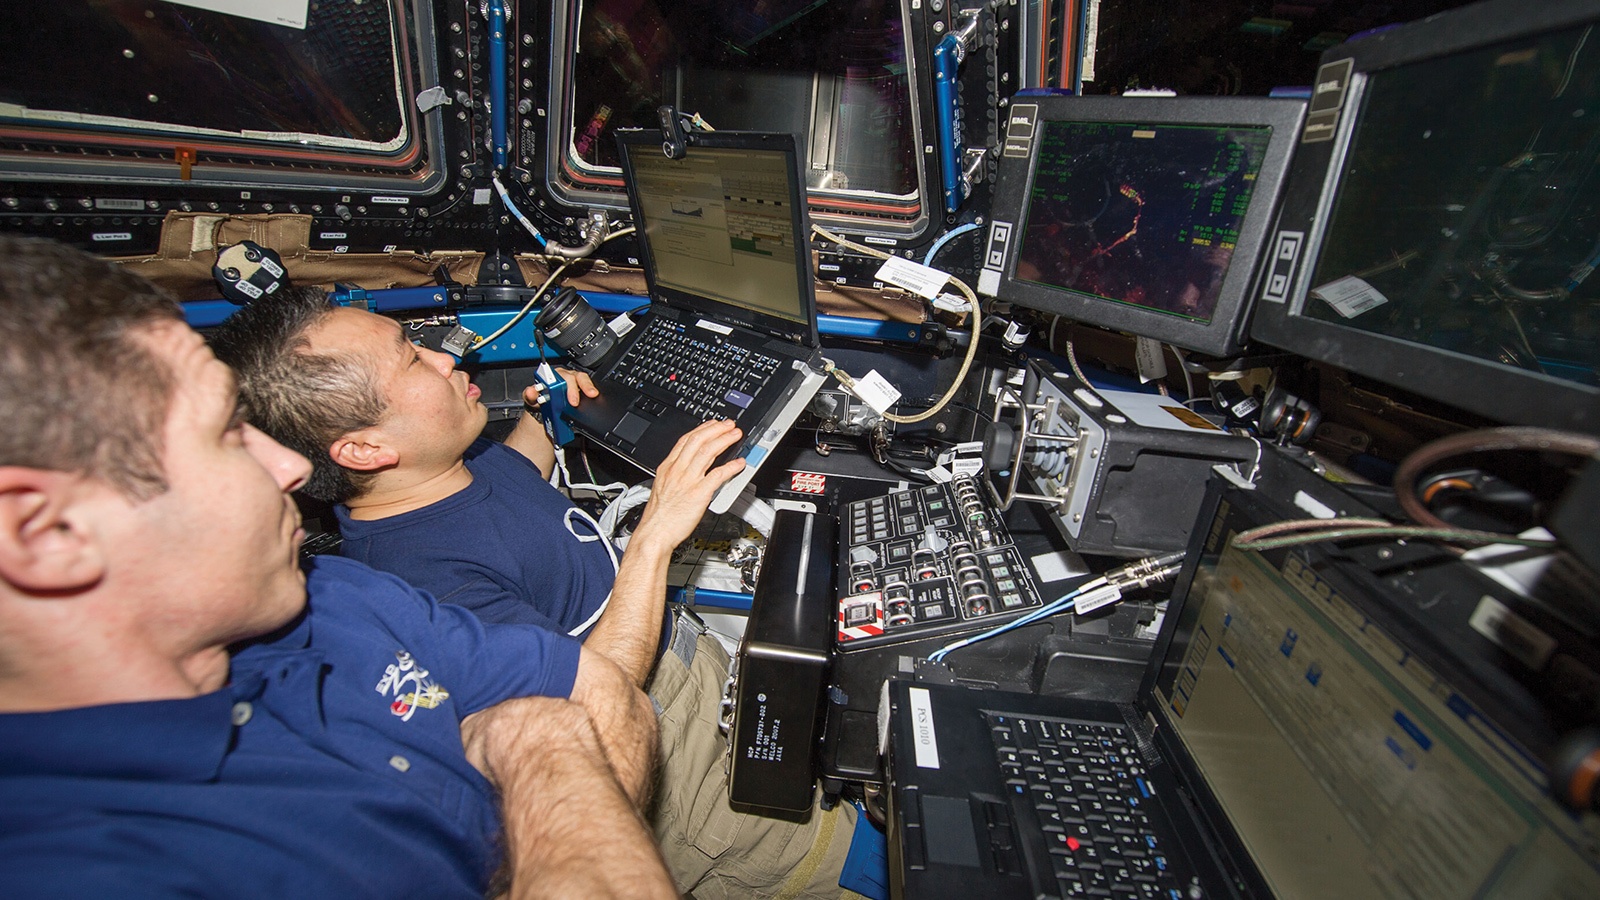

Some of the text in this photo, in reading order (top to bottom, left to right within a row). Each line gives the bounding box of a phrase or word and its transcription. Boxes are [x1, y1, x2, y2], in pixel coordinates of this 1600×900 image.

[771, 719, 780, 740] 2007.2
[916, 707, 930, 745] PCS 1010
[775, 746, 783, 762] JAXA
[1078, 765, 1088, 773] W
[1071, 804, 1080, 812] F
[1092, 802, 1102, 810] R
[1051, 812, 1060, 821] V
[1078, 825, 1088, 834] G
[1101, 823, 1111, 831] T
[1086, 848, 1097, 857] H
[1110, 845, 1120, 854] Y
[1064, 857, 1075, 867] N
[1118, 869, 1130, 878] U
[1072, 882, 1084, 893] M
